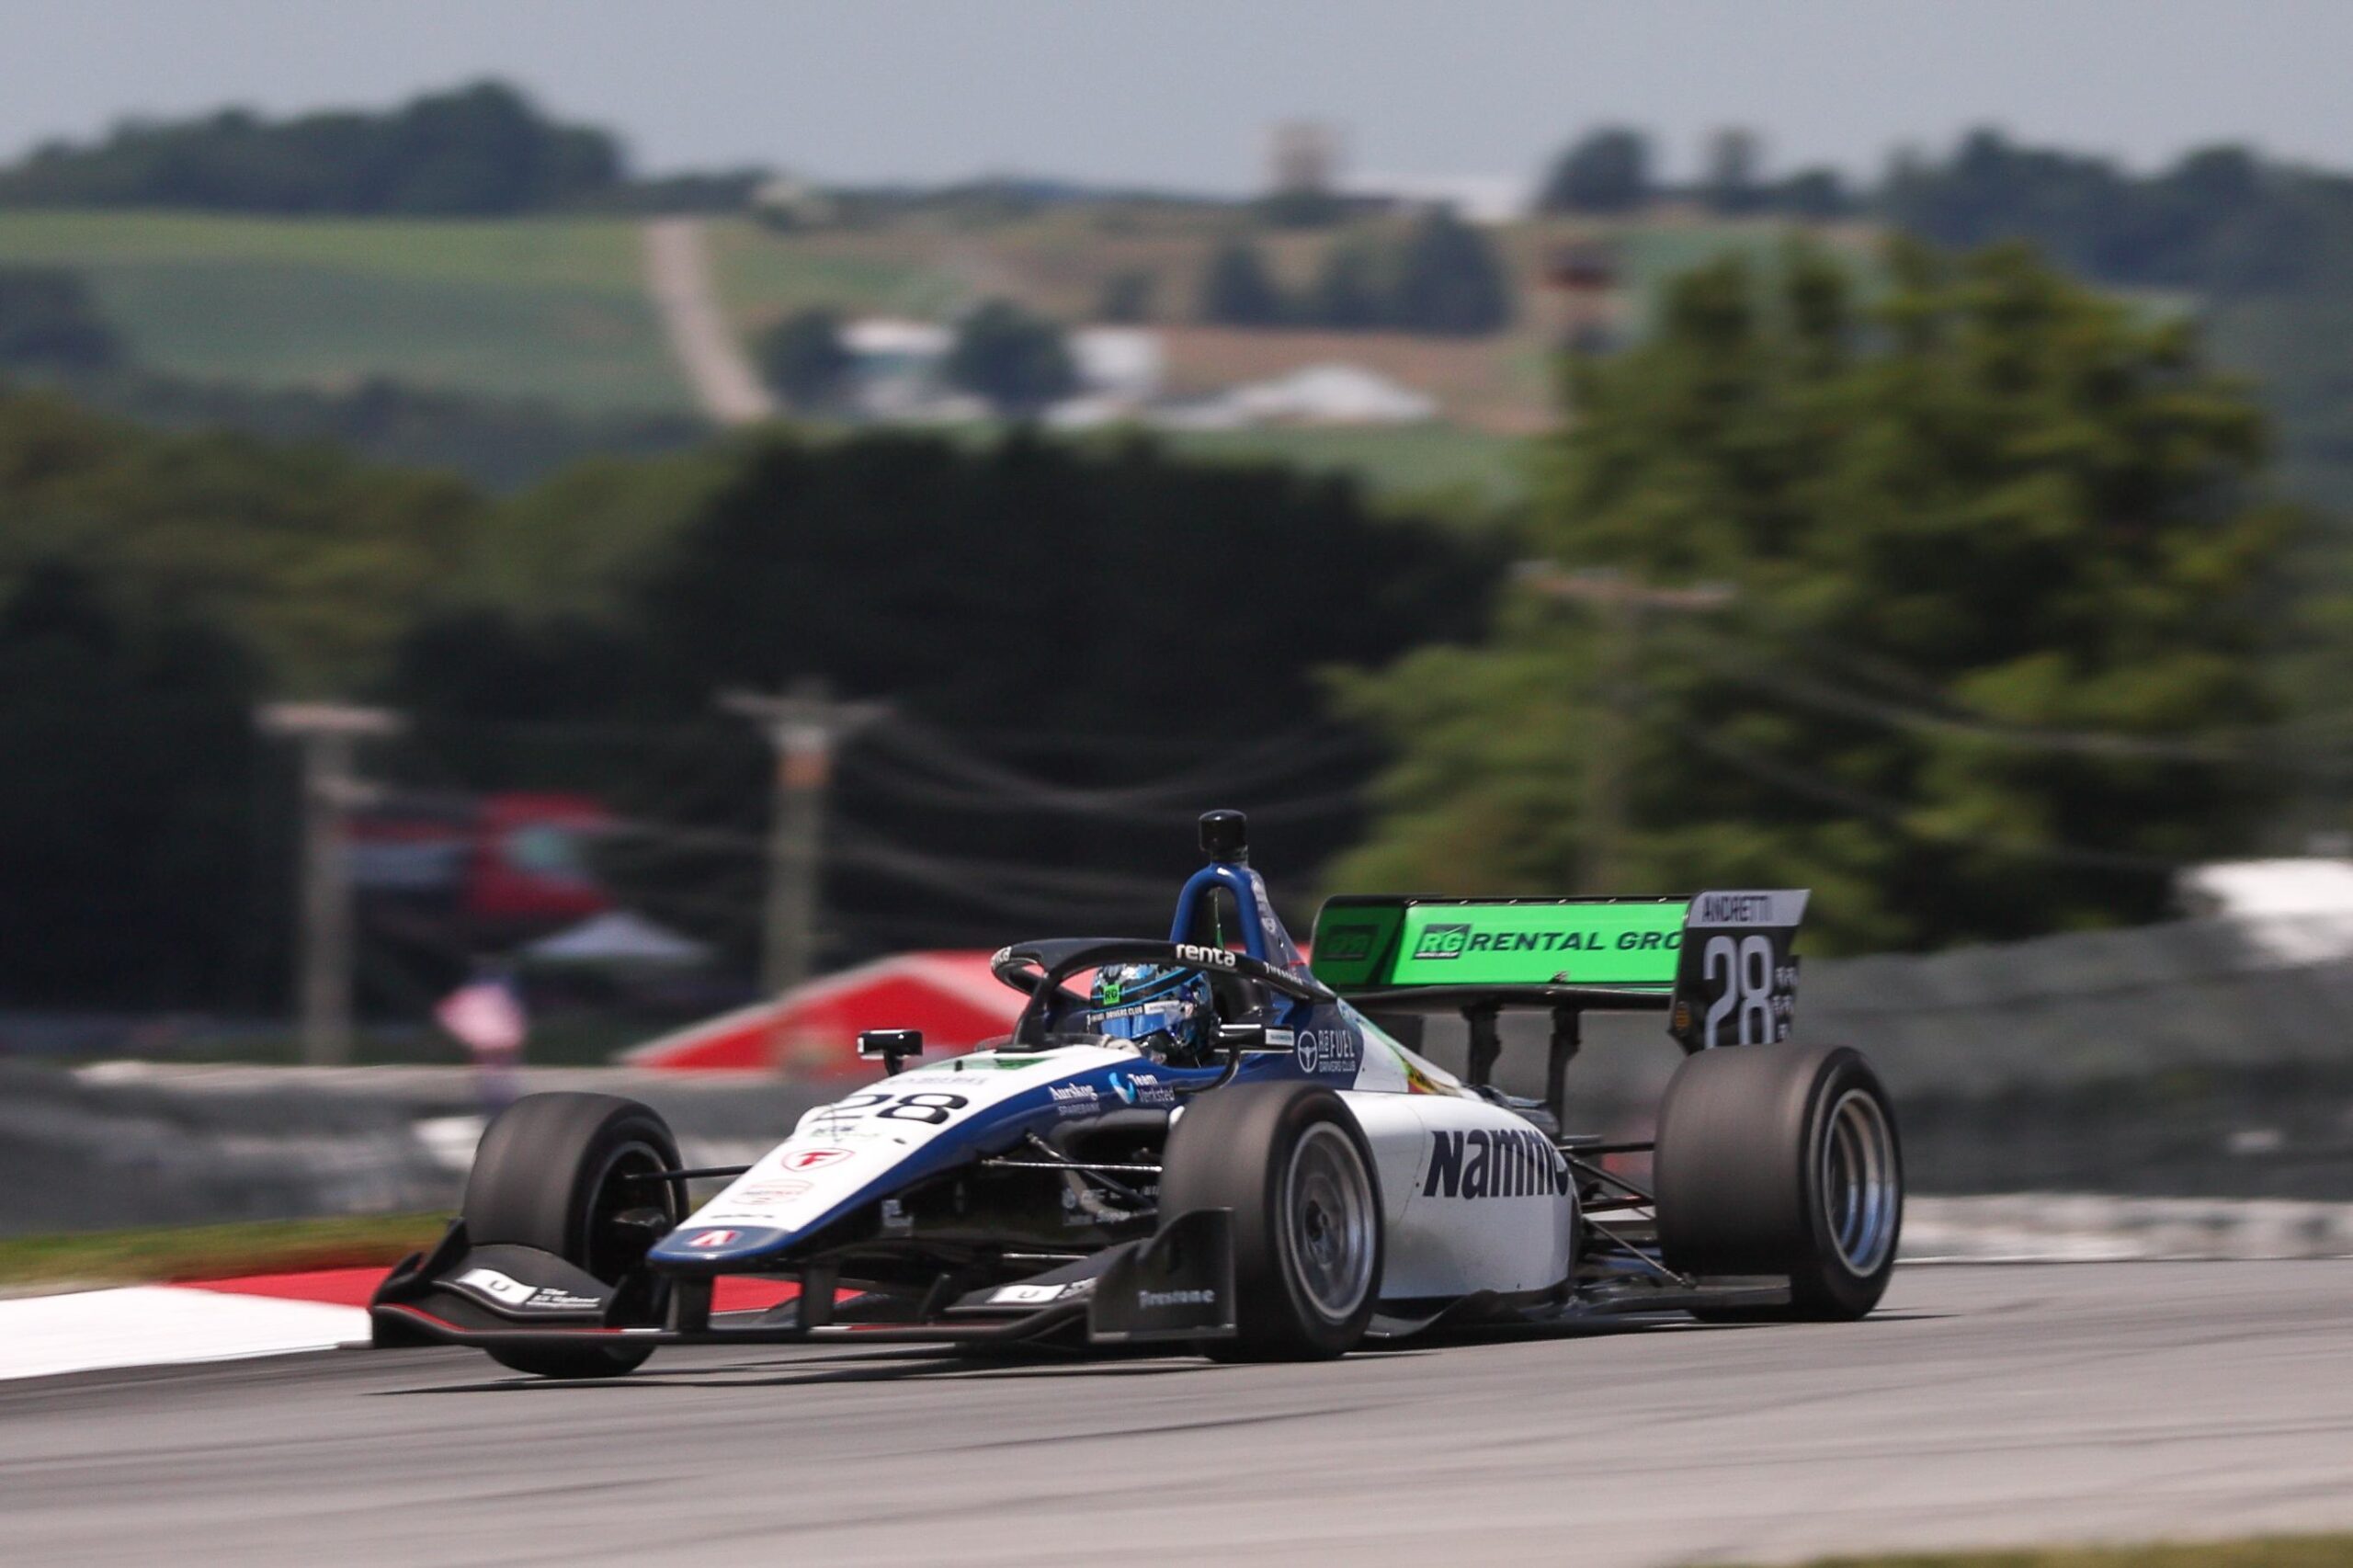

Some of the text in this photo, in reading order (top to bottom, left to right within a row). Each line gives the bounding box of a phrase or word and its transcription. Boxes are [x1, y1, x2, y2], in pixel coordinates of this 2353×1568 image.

[1703, 895, 1773, 922] ANDRETTI
[1417, 932, 1465, 953] RG
[1467, 932, 1605, 951] RENTAL
[1176, 943, 1236, 967] renta
[1703, 935, 1775, 1050] 28
[1126, 1073, 1158, 1085] Team
[1048, 1082, 1098, 1101] Aurskog
[810, 1093, 969, 1125] 28
